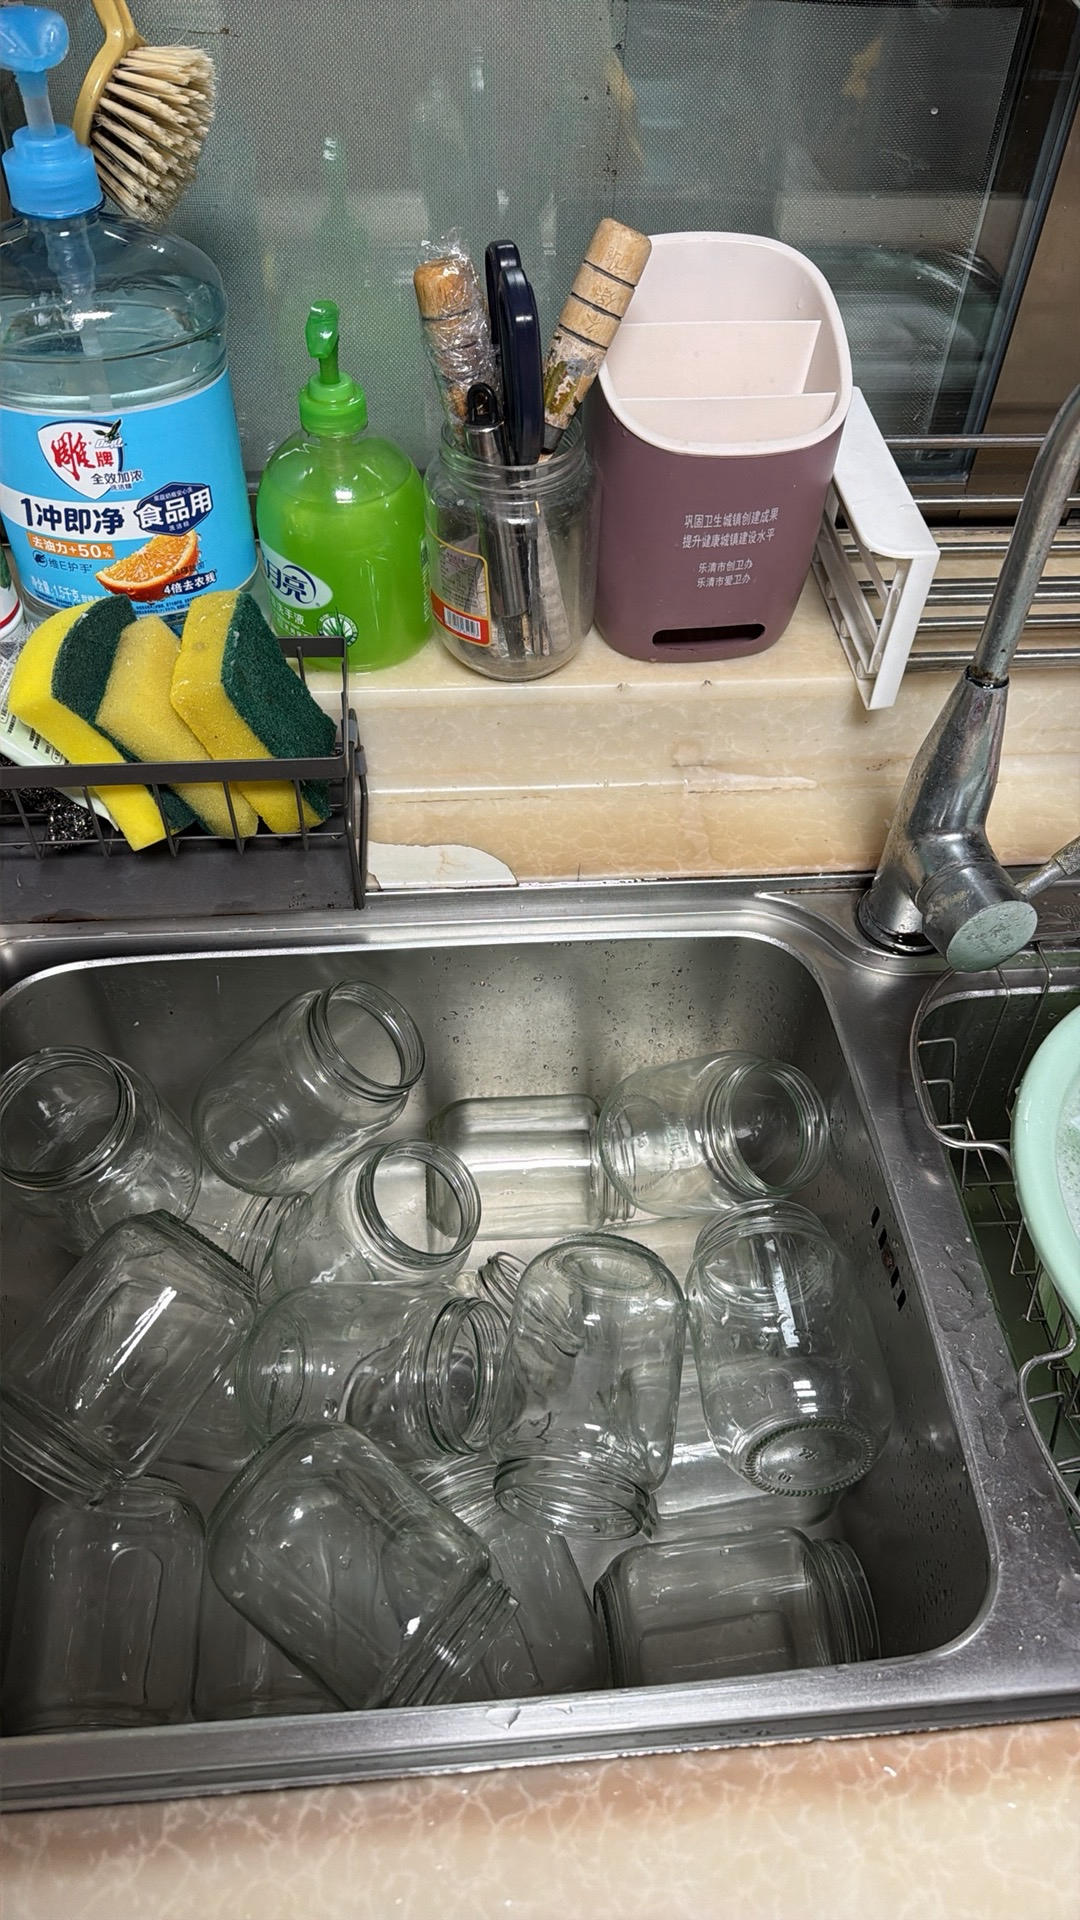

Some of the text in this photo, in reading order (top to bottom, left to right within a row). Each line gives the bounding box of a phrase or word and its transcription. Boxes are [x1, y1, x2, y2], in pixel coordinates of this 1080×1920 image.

[91, 470, 143, 485] 全效加浓
[21, 498, 125, 534] 1冲即净
[136, 487, 213, 529] 食品用
[684, 507, 779, 529] 巩固卫生城镇创建成果
[682, 528, 775, 549] 提升健康城镇建设水平
[699, 558, 753, 574] 乐清市创卫办
[164, 571, 216, 594] 4倍去农残
[697, 573, 751, 589] 乐清市爱卫办
